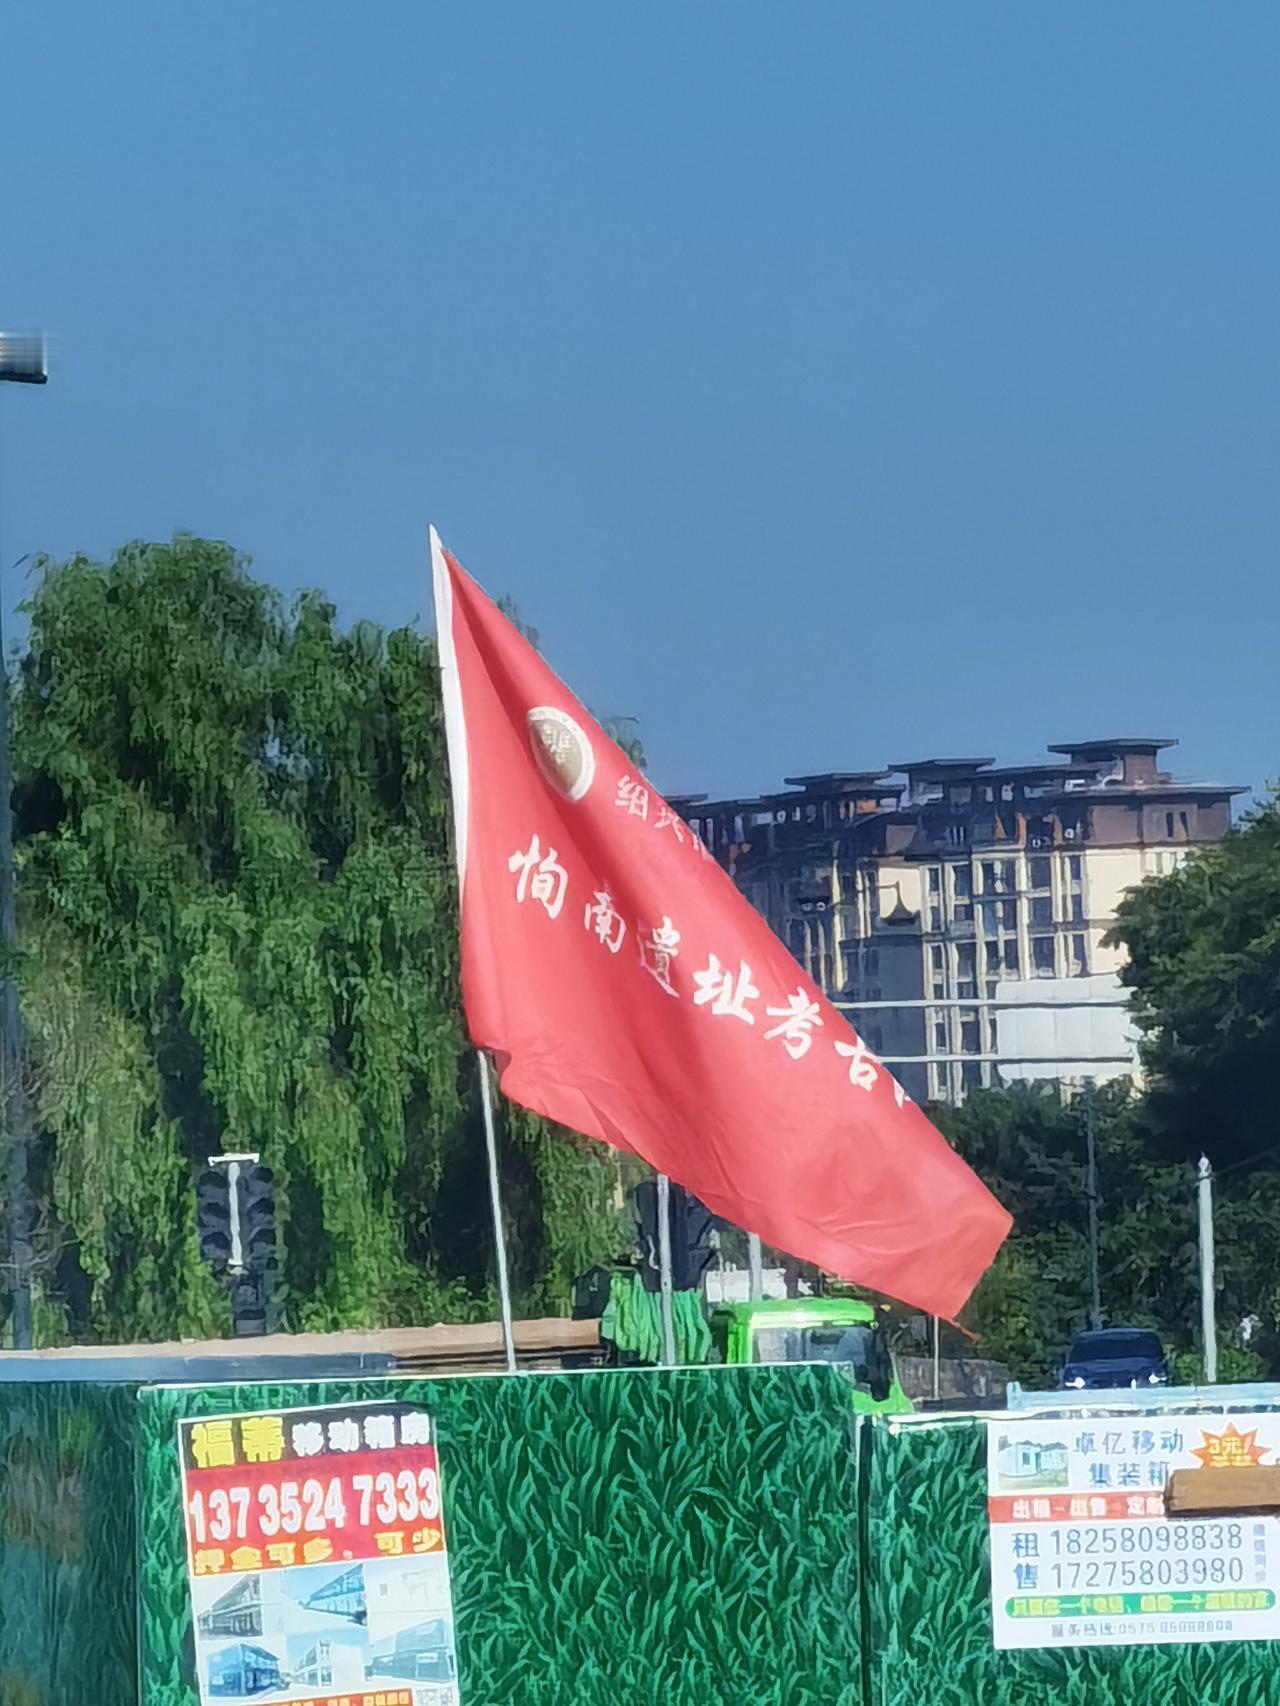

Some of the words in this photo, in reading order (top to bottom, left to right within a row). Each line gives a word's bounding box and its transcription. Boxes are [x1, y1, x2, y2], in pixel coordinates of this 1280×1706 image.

[189, 1487, 250, 1543] 137
[258, 1477, 346, 1536] 3524
[352, 1468, 439, 1526] 7333
[1011, 1532, 1040, 1558] 租
[1050, 1523, 1243, 1556] 18258098838
[1013, 1563, 1039, 1590] 售
[1050, 1557, 1244, 1589] 17275803980
